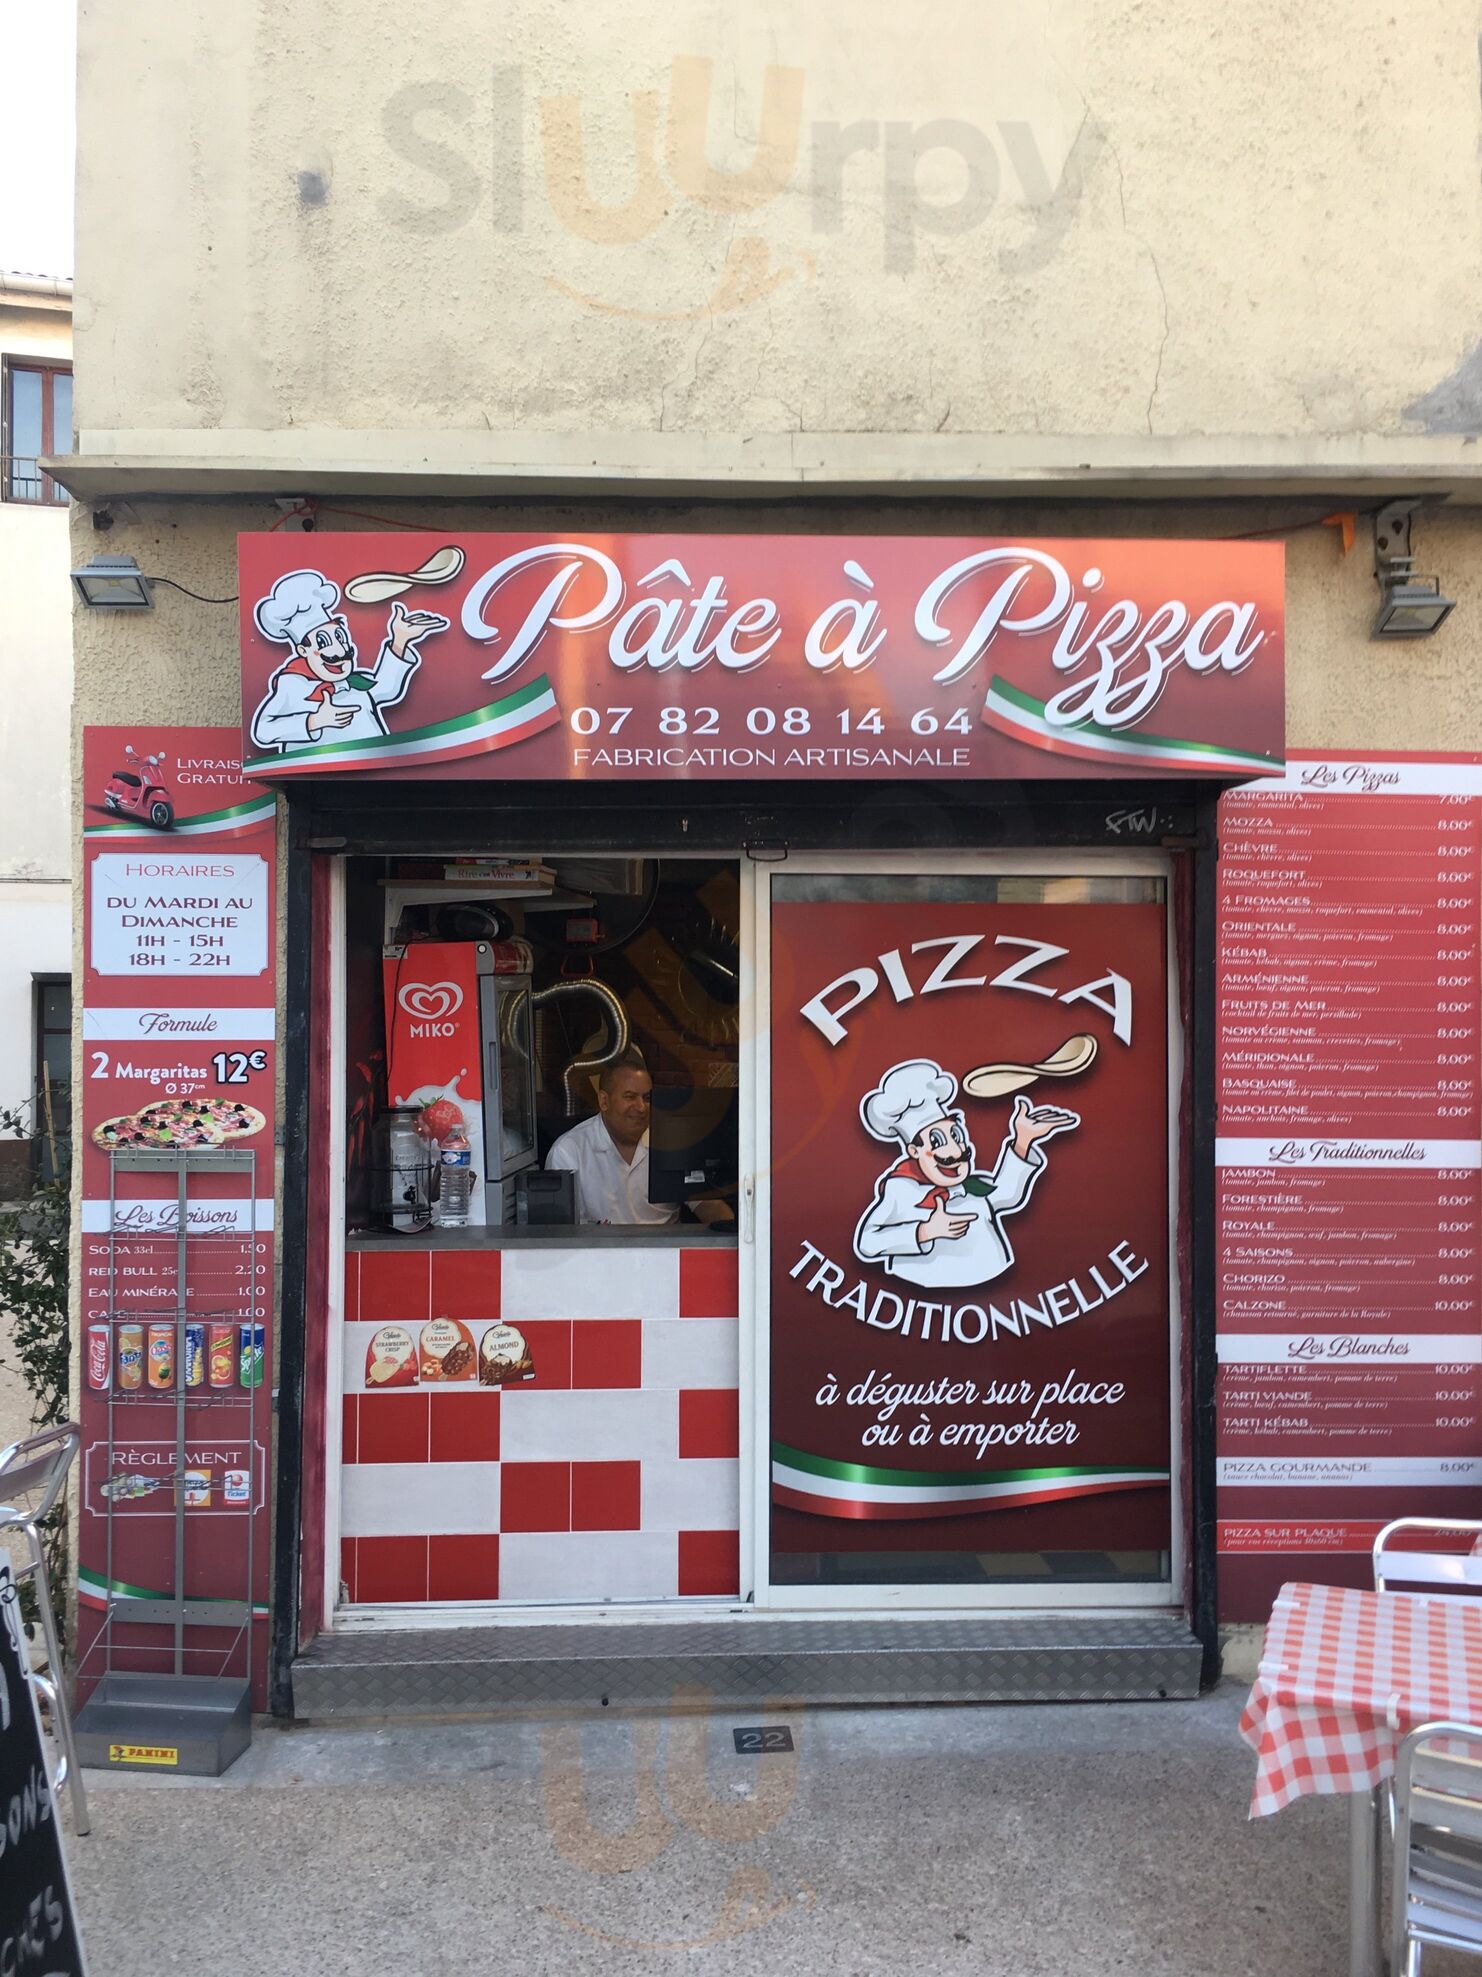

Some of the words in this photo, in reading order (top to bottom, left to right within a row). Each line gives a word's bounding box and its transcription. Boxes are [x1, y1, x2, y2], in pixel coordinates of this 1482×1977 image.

[461, 543, 783, 684] Pâte
[805, 560, 888, 674] à
[915, 546, 1265, 731] Pizza
[570, 706, 634, 735] 07
[659, 706, 720, 735] 82
[746, 706, 812, 735] 08
[836, 707, 885, 735] 14
[910, 707, 972, 735] 64
[574, 748, 775, 766] FABRICATION
[783, 748, 971, 766] ARTISANALE
[177, 758, 243, 769] LIVRAIS
[1301, 764, 1337, 788] Les
[1342, 764, 1401, 792] Pizzas
[1223, 816, 1274, 828] MOZZA
[1223, 841, 1277, 853] CHÈVRE
[126, 863, 235, 877] HORAIRES
[1223, 868, 1306, 880] ROQUEFORT
[107, 897, 137, 909] DU
[144, 897, 218, 909] MARDI
[225, 898, 253, 909] AU
[1222, 895, 1231, 905] 4
[1235, 895, 1311, 906] FROMAGES
[122, 915, 238, 928] DIMANCHE
[1222, 921, 1297, 932] ORIENTALE
[136, 934, 165, 947] 11H
[190, 934, 224, 947] 15H
[1221, 946, 1267, 958] KÉBAB
[129, 953, 165, 966] 18H
[189, 953, 231, 966] 22H
[1221, 972, 1309, 984] ARMÉNIENNE
[799, 934, 1133, 1047] PIZZA
[1221, 999, 1269, 1010] FRUITS
[1272, 1000, 1290, 1010] DE
[1295, 1000, 1326, 1011] MER
[139, 1013, 218, 1034] Formule
[410, 1023, 455, 1038] MIKO
[1222, 1024, 1317, 1036] NORVÉGIENNE
[1222, 1050, 1314, 1062] MÉRIDIONALE
[91, 1051, 109, 1079] 2
[115, 1062, 207, 1085] Margaritas
[212, 1049, 267, 1083] 12€
[1222, 1077, 1297, 1089] BASQUAISE
[1222, 1104, 1309, 1115] NAPOLITAINE
[1268, 1140, 1305, 1164] Les
[1309, 1140, 1427, 1162] Traditionnelles
[1221, 1167, 1276, 1179] JAMBON
[1222, 1192, 1303, 1204] FORESTIÈRE
[114, 1205, 153, 1227] Les
[1222, 1220, 1275, 1231] ROYALE
[88, 1245, 130, 1255] SODA
[1223, 1246, 1231, 1257] 4
[1236, 1247, 1294, 1257] SAISONS
[123, 1267, 157, 1276] BULL
[1223, 1273, 1286, 1284] CHORIZO
[122, 1286, 194, 1297] MINÉRAE
[788, 1239, 1149, 1344] TRADITIONNELLE
[1223, 1299, 1287, 1310] CALZONE
[489, 1341, 519, 1351] ALMOND
[1288, 1337, 1324, 1359] Les
[1327, 1337, 1410, 1358] Blanches
[1223, 1364, 1308, 1375] TARTIFLETTE
[815, 1373, 841, 1405] à
[846, 1369, 979, 1421] déguster
[982, 1379, 1034, 1405] sur
[1031, 1368, 1125, 1419] place
[1223, 1391, 1260, 1401] TARTI
[1263, 1391, 1312, 1401] VIANDE
[1223, 1417, 1260, 1427] TARTI
[1264, 1415, 1309, 1427] KÉBAB
[861, 1425, 903, 1446] ou
[908, 1413, 934, 1446] à
[939, 1417, 1080, 1460] emporter
[112, 1449, 242, 1465] RÈGLEMENT
[1223, 1462, 1266, 1472] PIZZA
[1270, 1462, 1372, 1473] GOURMANDE
[1223, 1528, 1262, 1537] PIZZA
[1264, 1528, 1291, 1537] SUR
[1295, 1528, 1347, 1539] PLAQUE
[742, 1731, 786, 1749] 22
[128, 1748, 175, 1759] PANINI
